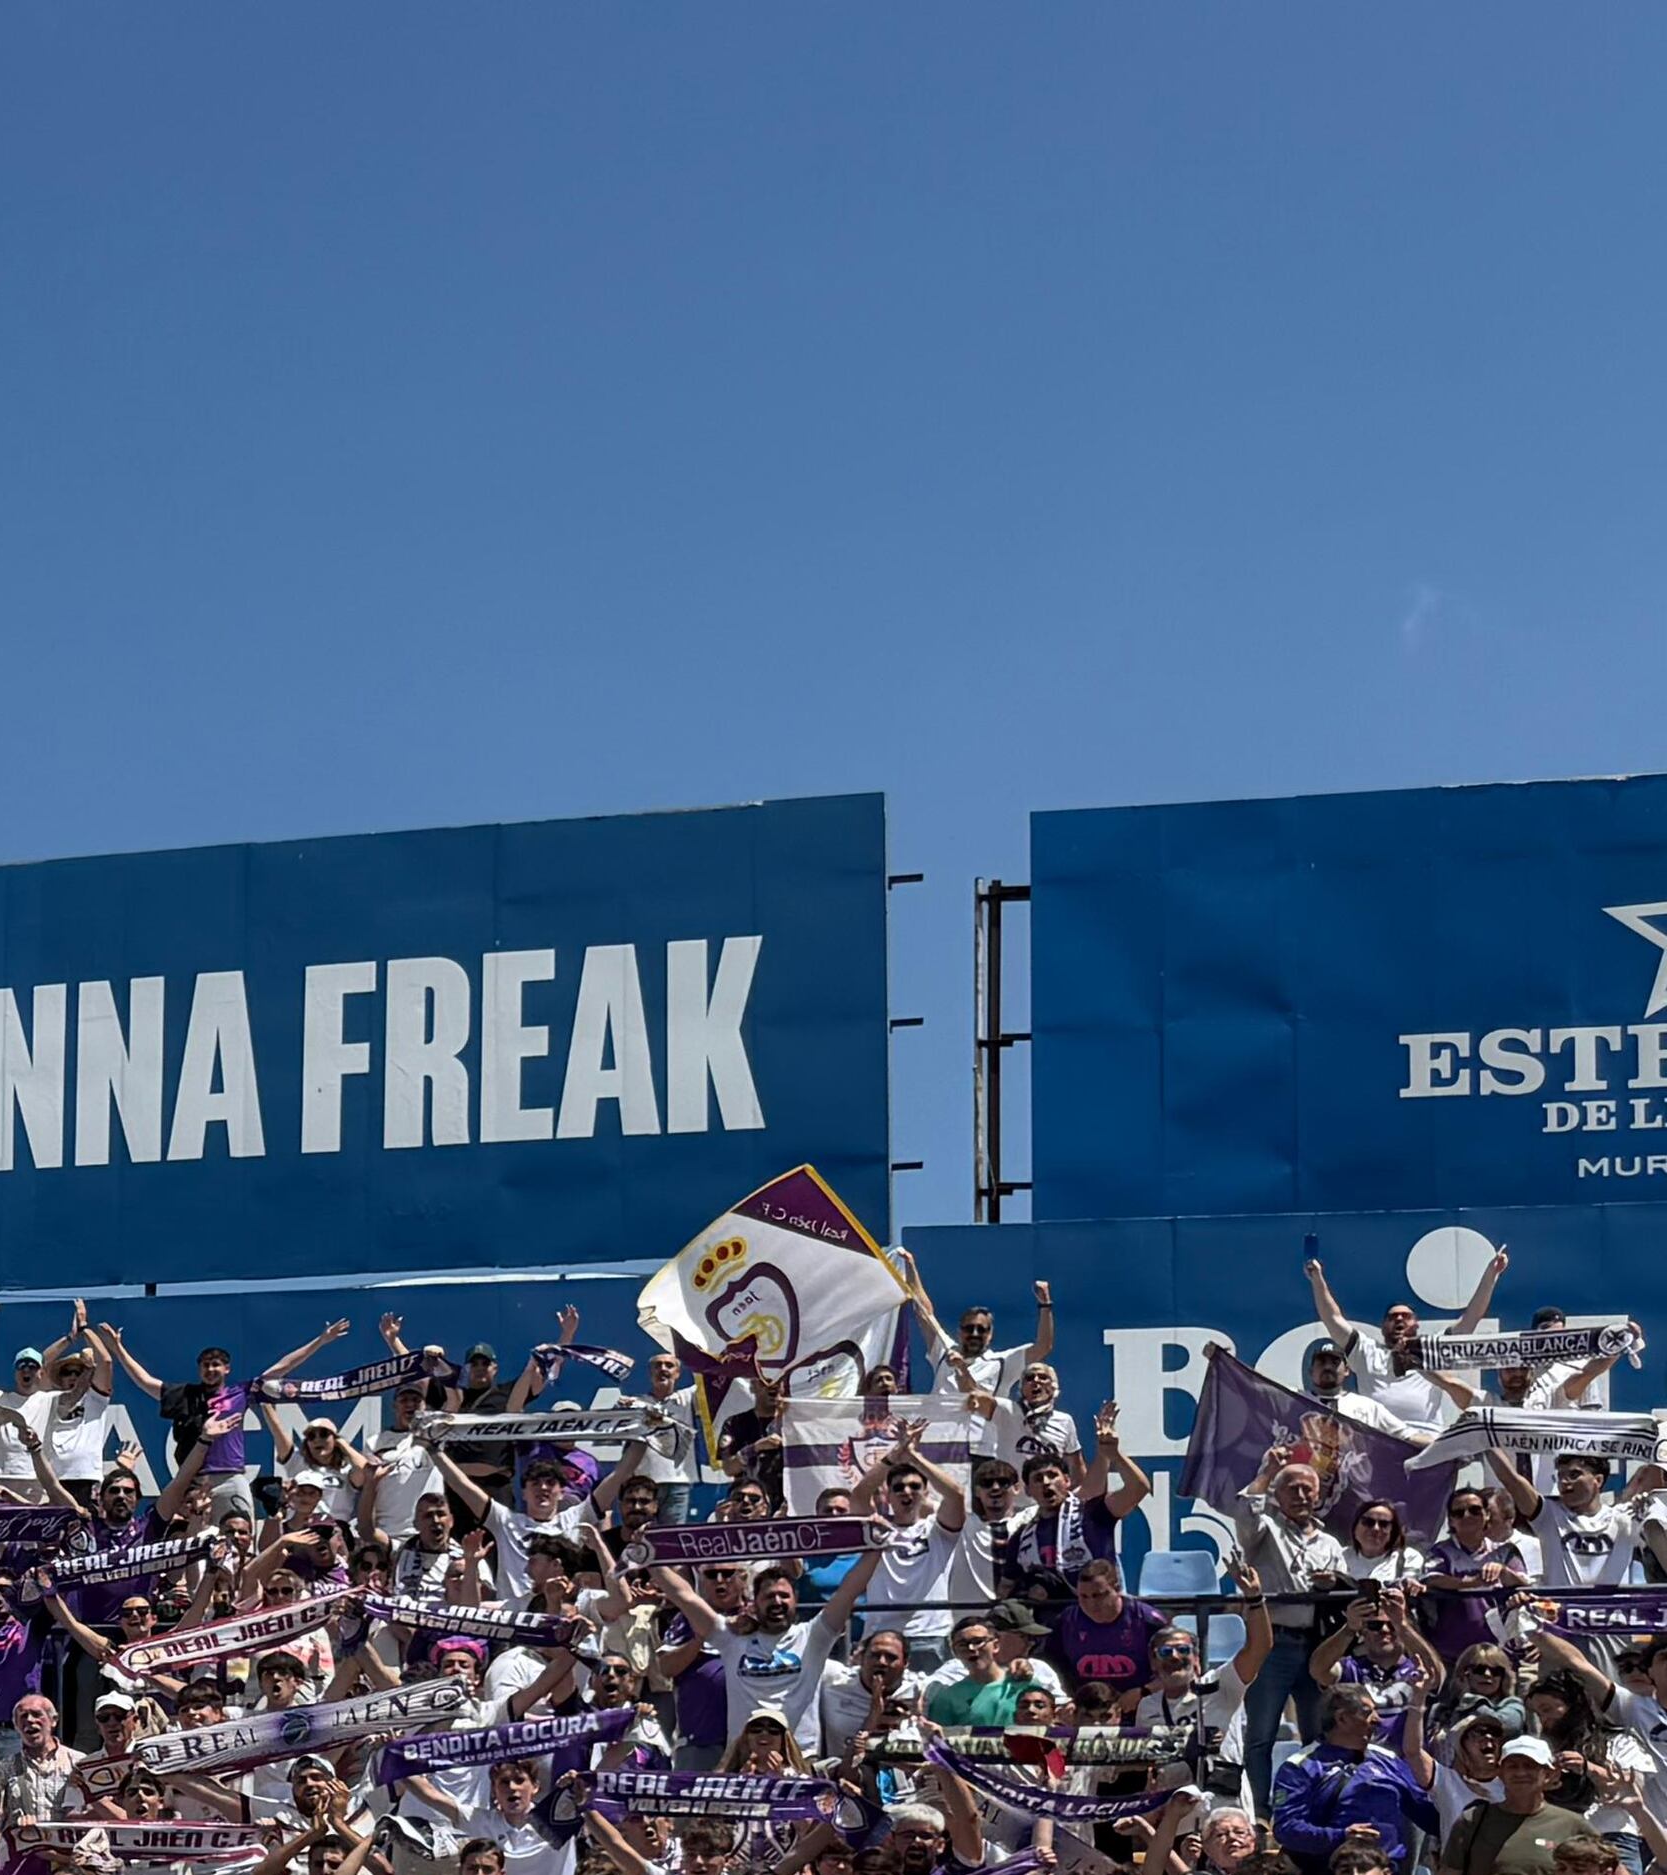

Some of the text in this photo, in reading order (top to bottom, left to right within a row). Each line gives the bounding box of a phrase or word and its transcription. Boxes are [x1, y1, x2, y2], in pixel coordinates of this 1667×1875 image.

[301, 935, 765, 1154] FREAK
[1543, 1101, 1598, 1132] DE
[467, 1420, 531, 1436] REAL
[56, 1553, 116, 1577] REAL
[1566, 1606, 1642, 1628] REAL
[165, 1631, 222, 1658] REAL
[181, 1728, 260, 1761] REAL
[403, 1713, 602, 1762] BENDITA LOCURA
[595, 1771, 813, 1801] REAL JAÉN CF
